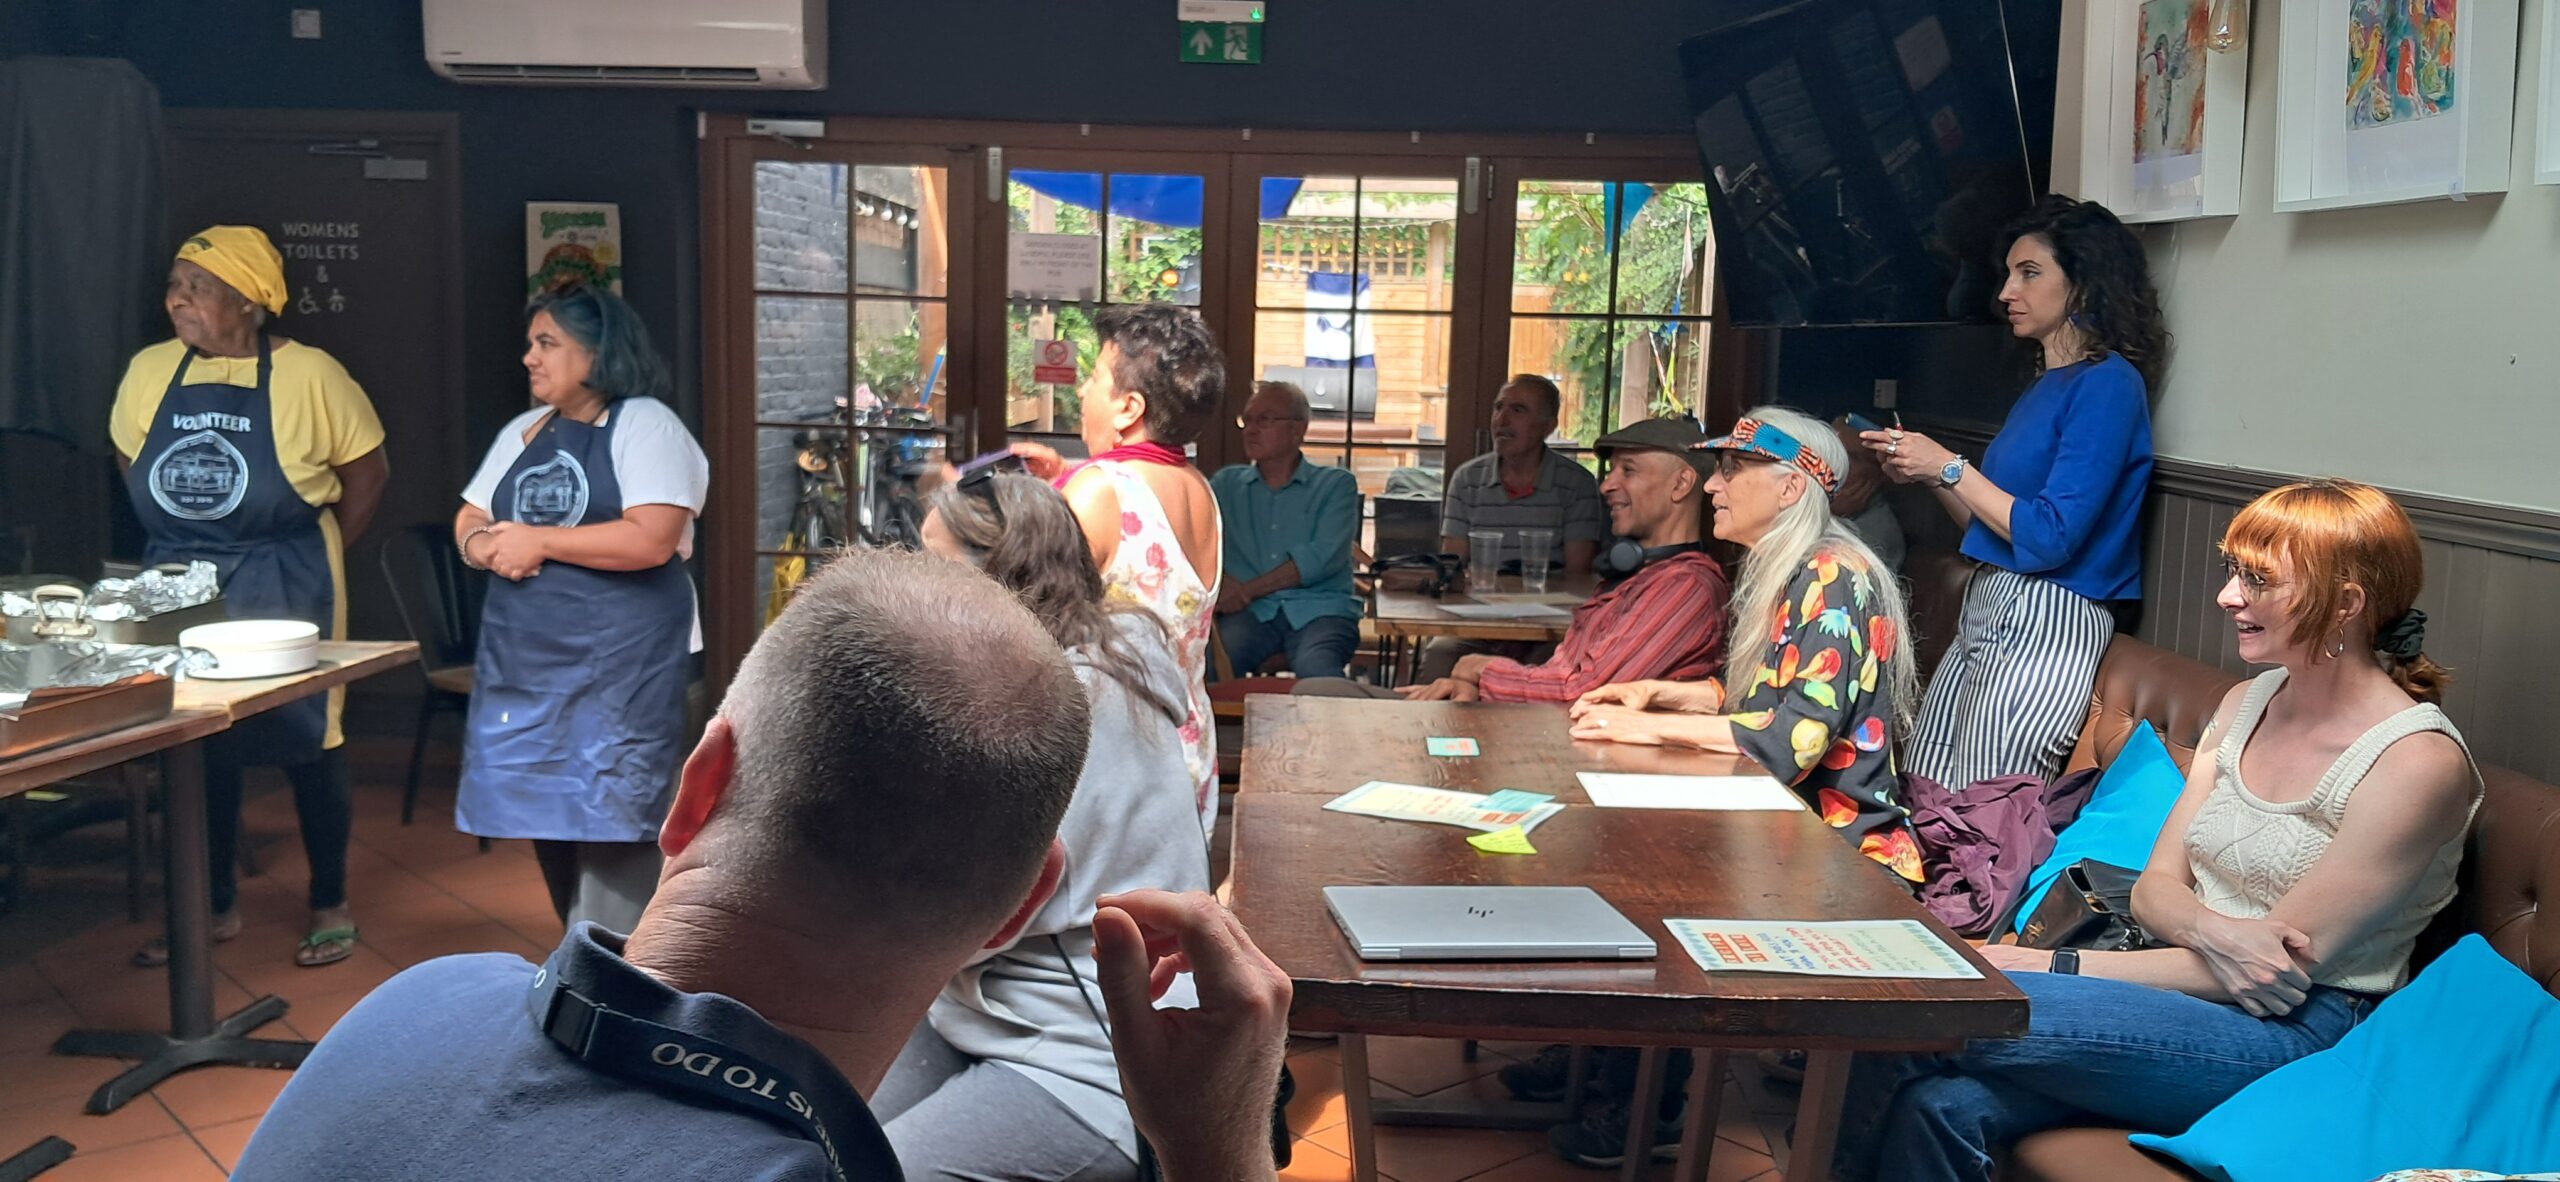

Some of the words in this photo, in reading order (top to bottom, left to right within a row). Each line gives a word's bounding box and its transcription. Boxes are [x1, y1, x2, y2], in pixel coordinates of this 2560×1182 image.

[282, 222, 359, 238] WOMENS
[283, 244, 360, 260] TOILETS
[317, 265, 328, 283] &
[1701, 932, 1744, 963] RECIPES
[652, 1042, 722, 1077] DO
[723, 1065, 778, 1100] TO
